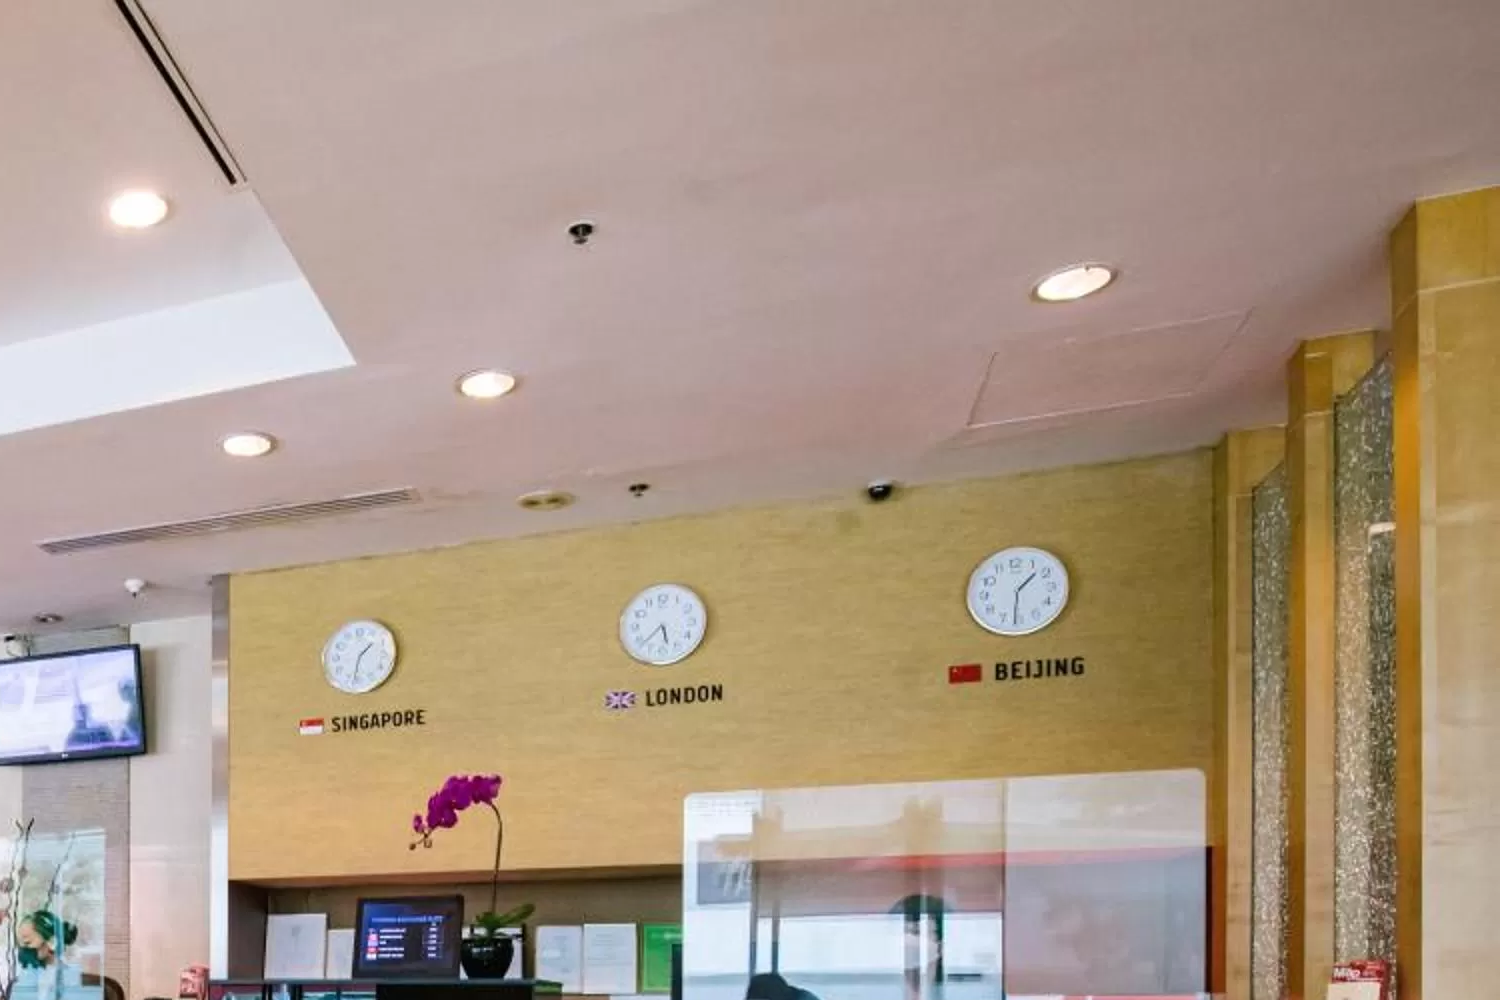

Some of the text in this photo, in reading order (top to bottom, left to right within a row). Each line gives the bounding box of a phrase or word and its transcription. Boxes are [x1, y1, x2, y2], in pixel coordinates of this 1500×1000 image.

[995, 656, 1085, 681] BEIJING
[645, 684, 723, 707] LONDON
[331, 709, 427, 733] SINGAPORE
